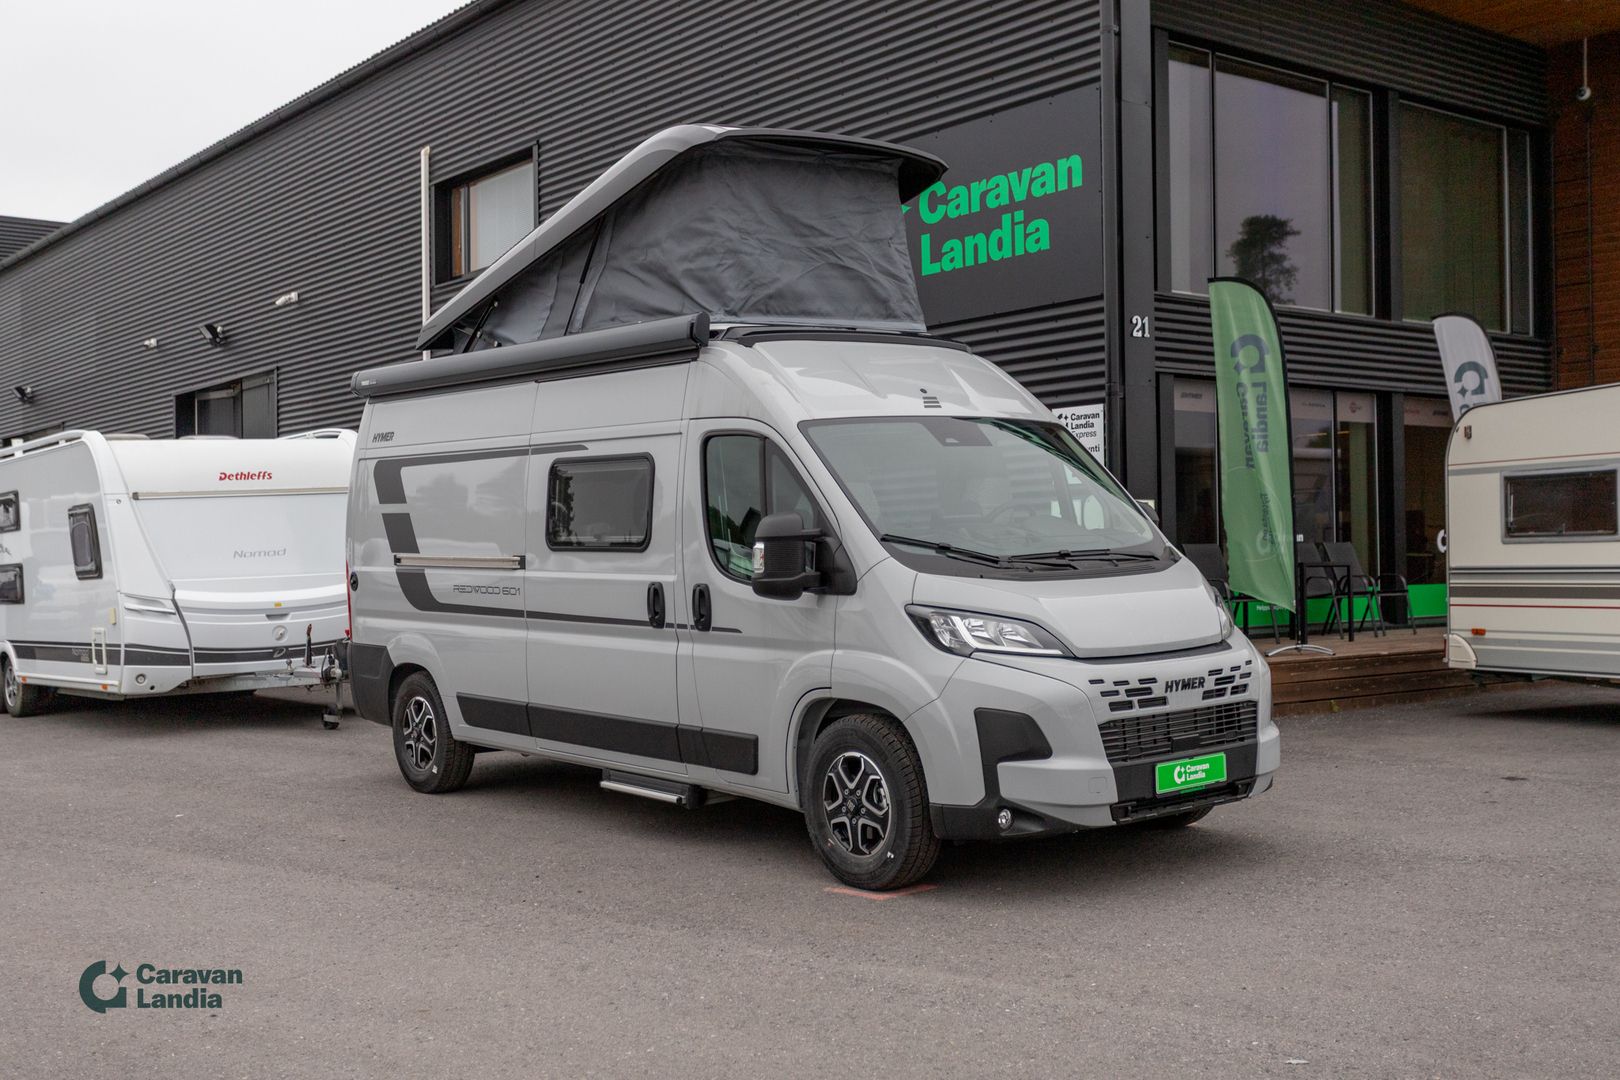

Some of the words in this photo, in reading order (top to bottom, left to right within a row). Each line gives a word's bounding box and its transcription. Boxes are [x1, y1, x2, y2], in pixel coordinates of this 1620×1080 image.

[919, 154, 1083, 224] Caravan
[921, 210, 1051, 276] Landia
[1132, 315, 1150, 338] 21
[1070, 413, 1100, 421] Caravan
[1071, 420, 1095, 429] Landia
[372, 431, 395, 443] HYMER
[219, 471, 273, 481] Dethleffs
[233, 548, 287, 559] Nomad
[453, 584, 501, 595] REDWOOD
[502, 586, 521, 596] 601
[1164, 676, 1206, 693] HYMER
[1186, 763, 1210, 772] Caravan
[1186, 770, 1206, 781] Landia
